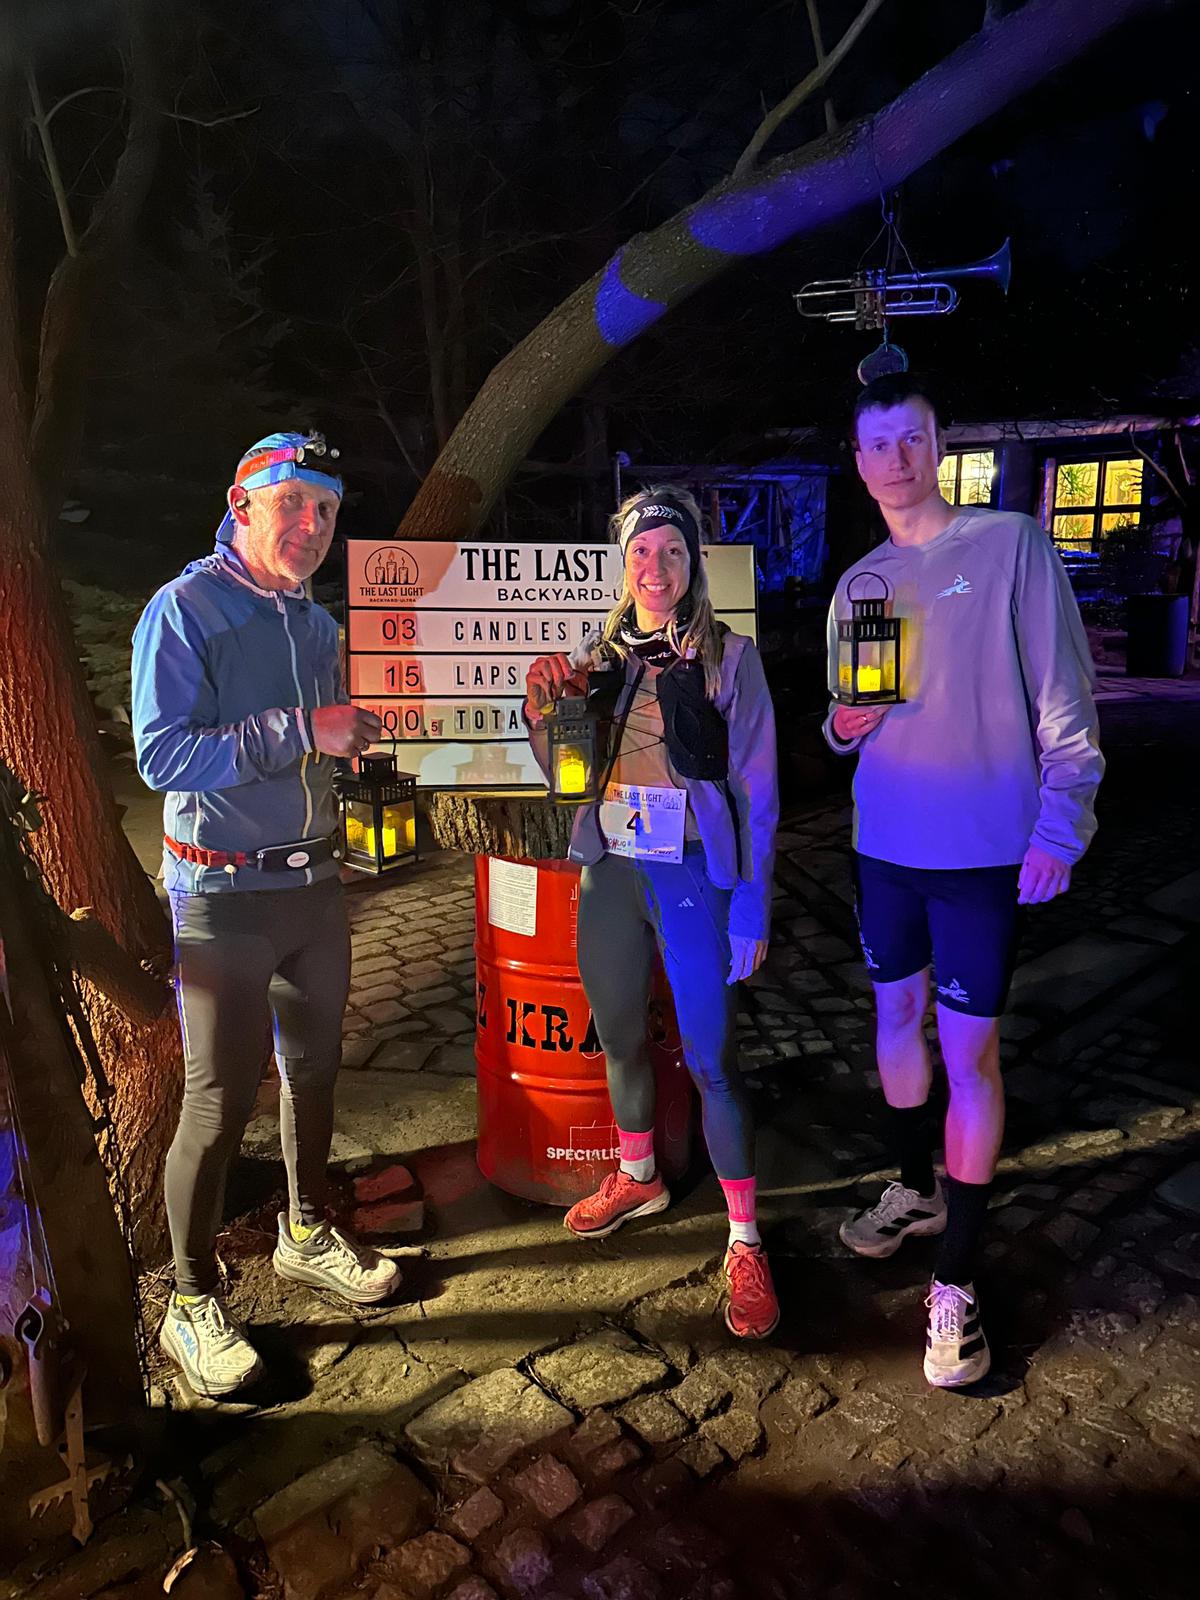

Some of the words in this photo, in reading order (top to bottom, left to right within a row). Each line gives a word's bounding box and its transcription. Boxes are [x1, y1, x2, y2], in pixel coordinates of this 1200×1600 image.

[460, 548, 521, 581] THE
[534, 549, 608, 582] LAST
[360, 587, 376, 597] THE
[378, 587, 398, 597] LAST
[400, 587, 425, 597] LIGHT
[497, 588, 622, 602] BACKYARD-U
[382, 619, 416, 641] 03
[455, 621, 567, 641] CANDLES
[385, 666, 420, 687] 15
[456, 666, 517, 686] LAPS
[457, 710, 520, 730] TOTA
[613, 789, 624, 799] THE
[624, 791, 640, 801] LAST
[641, 793, 663, 803] LIGHT
[626, 811, 641, 836] 4
[506, 998, 606, 1053] KRA
[546, 1147, 621, 1161] SPECIALIS
